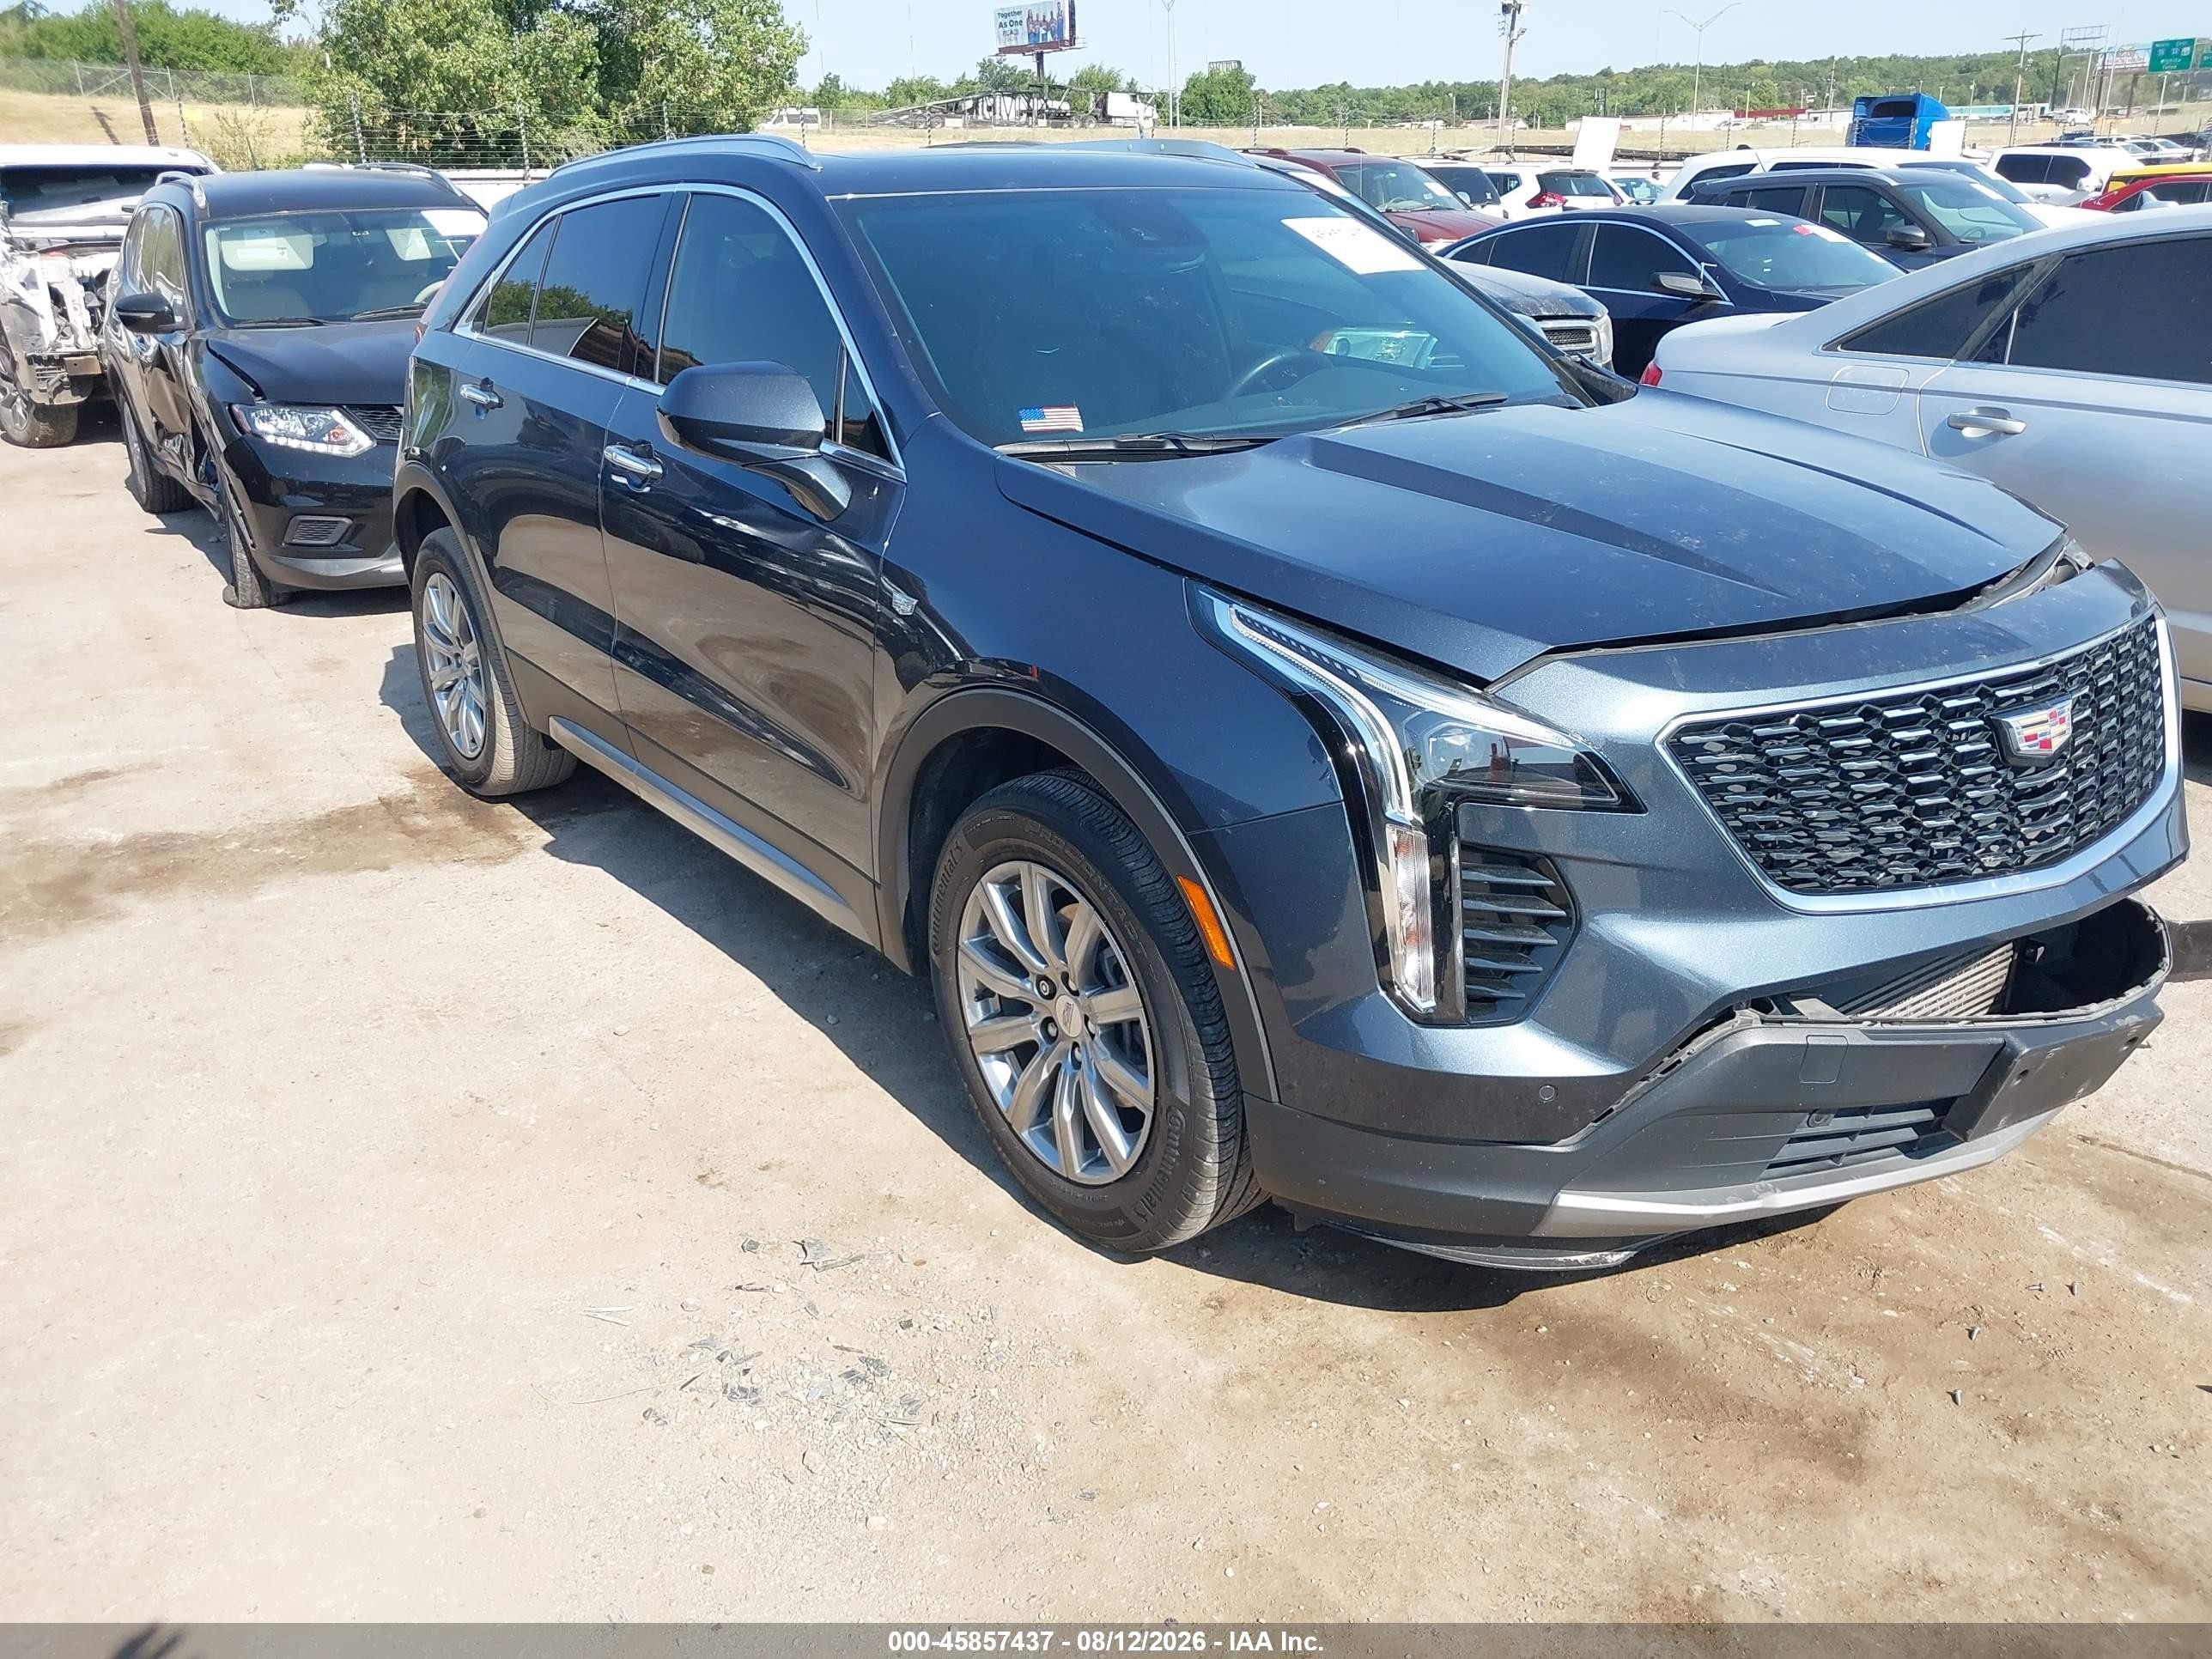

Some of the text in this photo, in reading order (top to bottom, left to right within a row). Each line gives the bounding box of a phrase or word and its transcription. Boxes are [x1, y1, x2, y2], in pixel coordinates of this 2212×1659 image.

[997, 9, 1023, 19] Together
[930, 848, 959, 957] Continental
[1140, 1105, 1187, 1217] Continental
